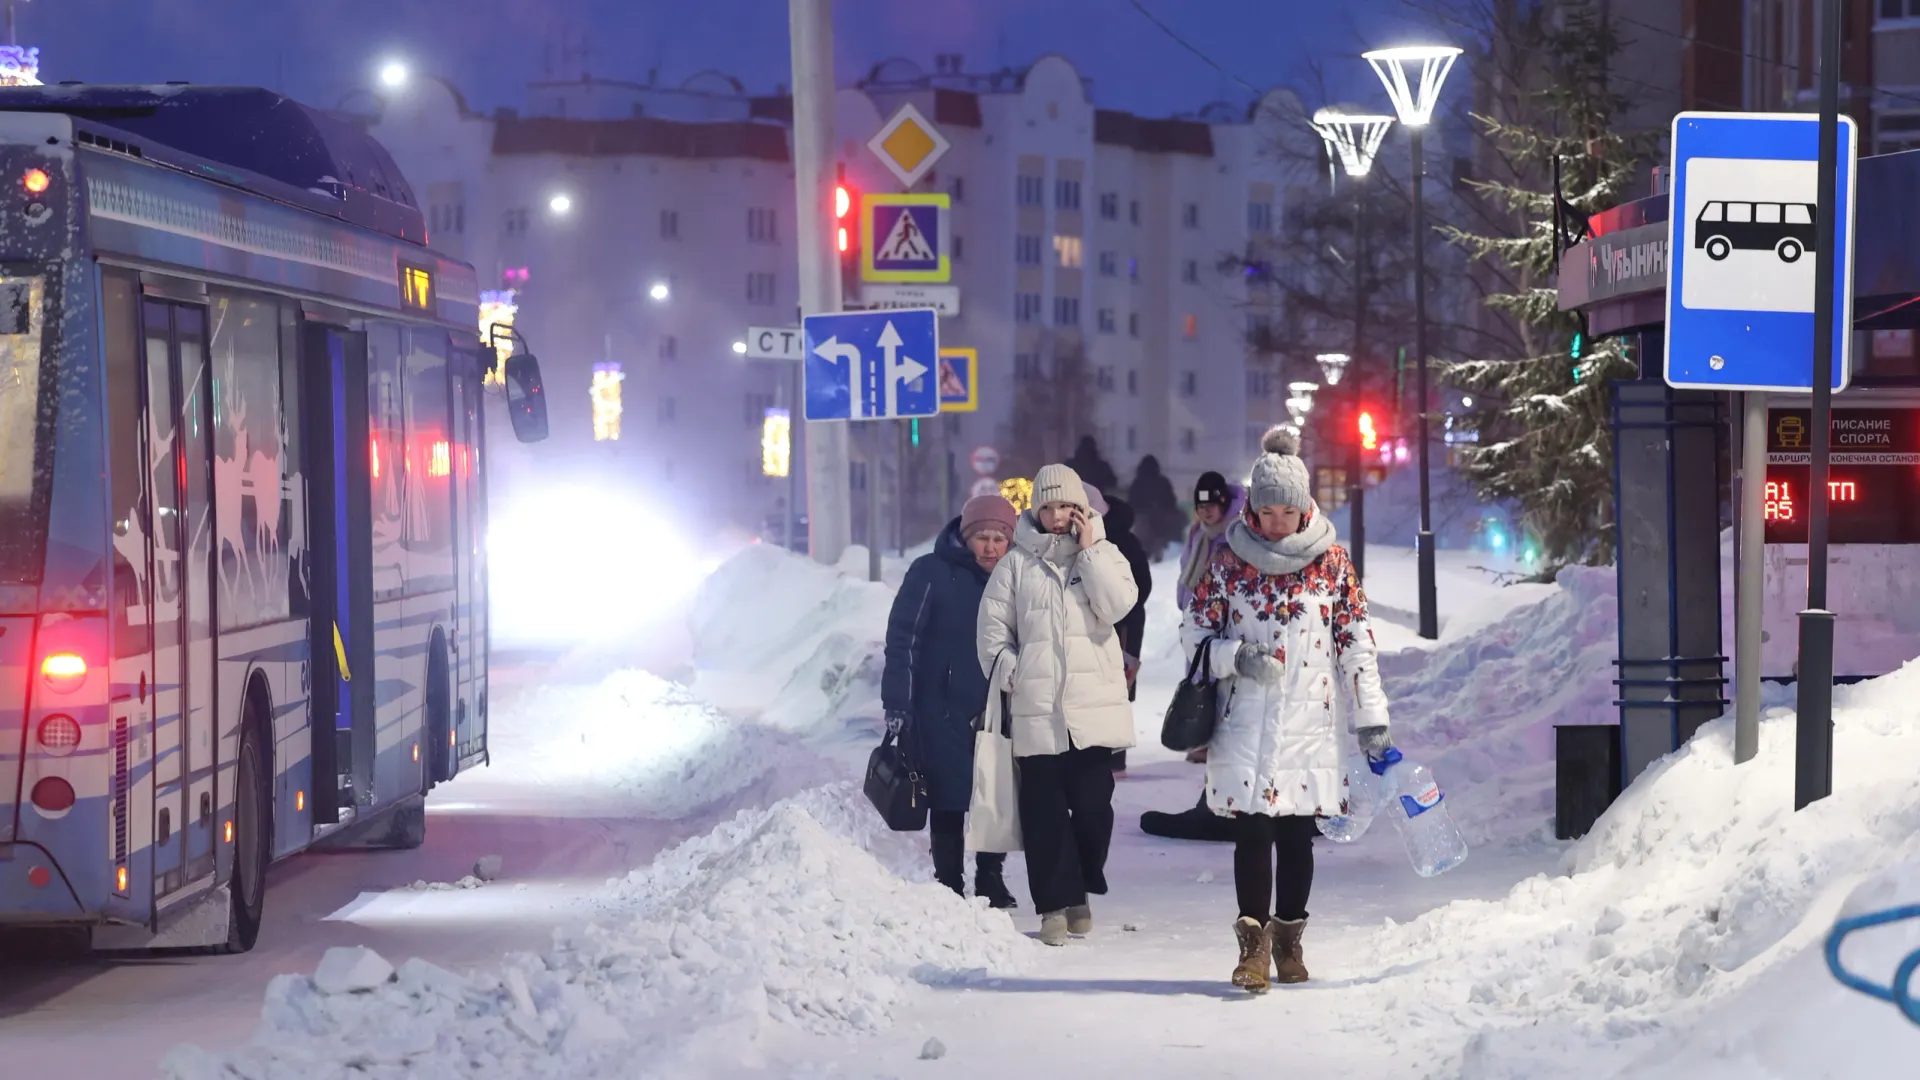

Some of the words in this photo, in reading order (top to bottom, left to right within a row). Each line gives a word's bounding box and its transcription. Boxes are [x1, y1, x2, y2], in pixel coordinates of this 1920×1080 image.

[758, 331, 802, 354] СТ
[1831, 419, 1891, 430] ПИСАНИЕ
[1839, 433, 1890, 444] СПОРТА
[1831, 454, 1877, 463] КОНЕЧНАЯ
[1879, 454, 1920, 463] ОСТАНОВ
